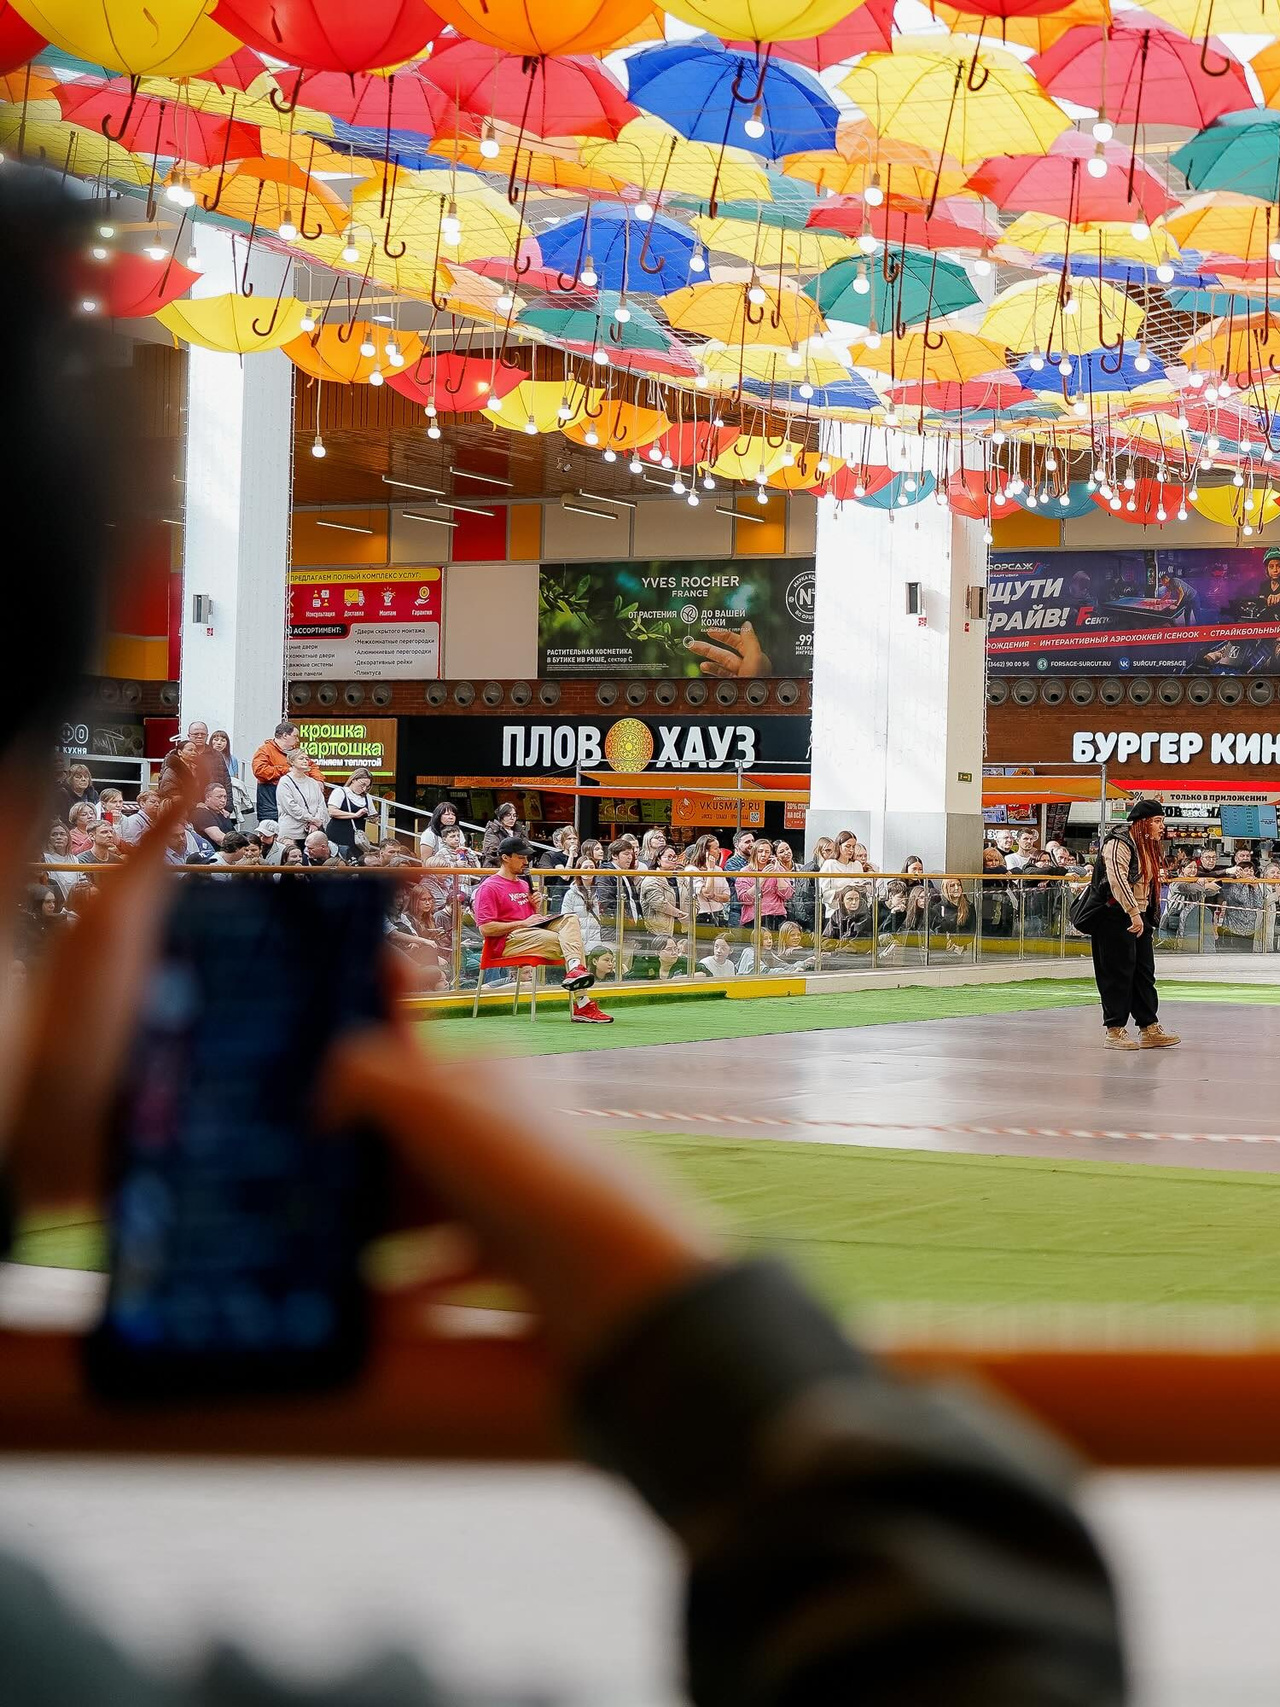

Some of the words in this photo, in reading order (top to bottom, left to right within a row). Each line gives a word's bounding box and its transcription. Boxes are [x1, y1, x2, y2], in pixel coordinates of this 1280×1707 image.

[641, 577, 676, 588] YVES
[681, 576, 740, 587] ROCHER
[640, 610, 677, 618] РАСТЕНИЯ
[701, 610, 712, 618] ДО
[715, 609, 746, 617] ВАШЕЙ
[987, 604, 1070, 632] РАЙВ!
[294, 626, 342, 634] АССОРТИМЕНТ:
[1040, 635, 1108, 646] ИНТЕРАКТИВНЫЙ
[1110, 632, 1162, 642] АЭРОХОККЕЙ
[300, 724, 366, 741] крошка
[502, 726, 602, 767] ПЛОВ
[656, 725, 756, 769] ХАУЗ
[1073, 732, 1203, 764] БУРГЕР
[345, 758, 382, 766] теплотой
[1210, 794, 1268, 802] приложении
[700, 802, 760, 810] VKUSMAP.RU
